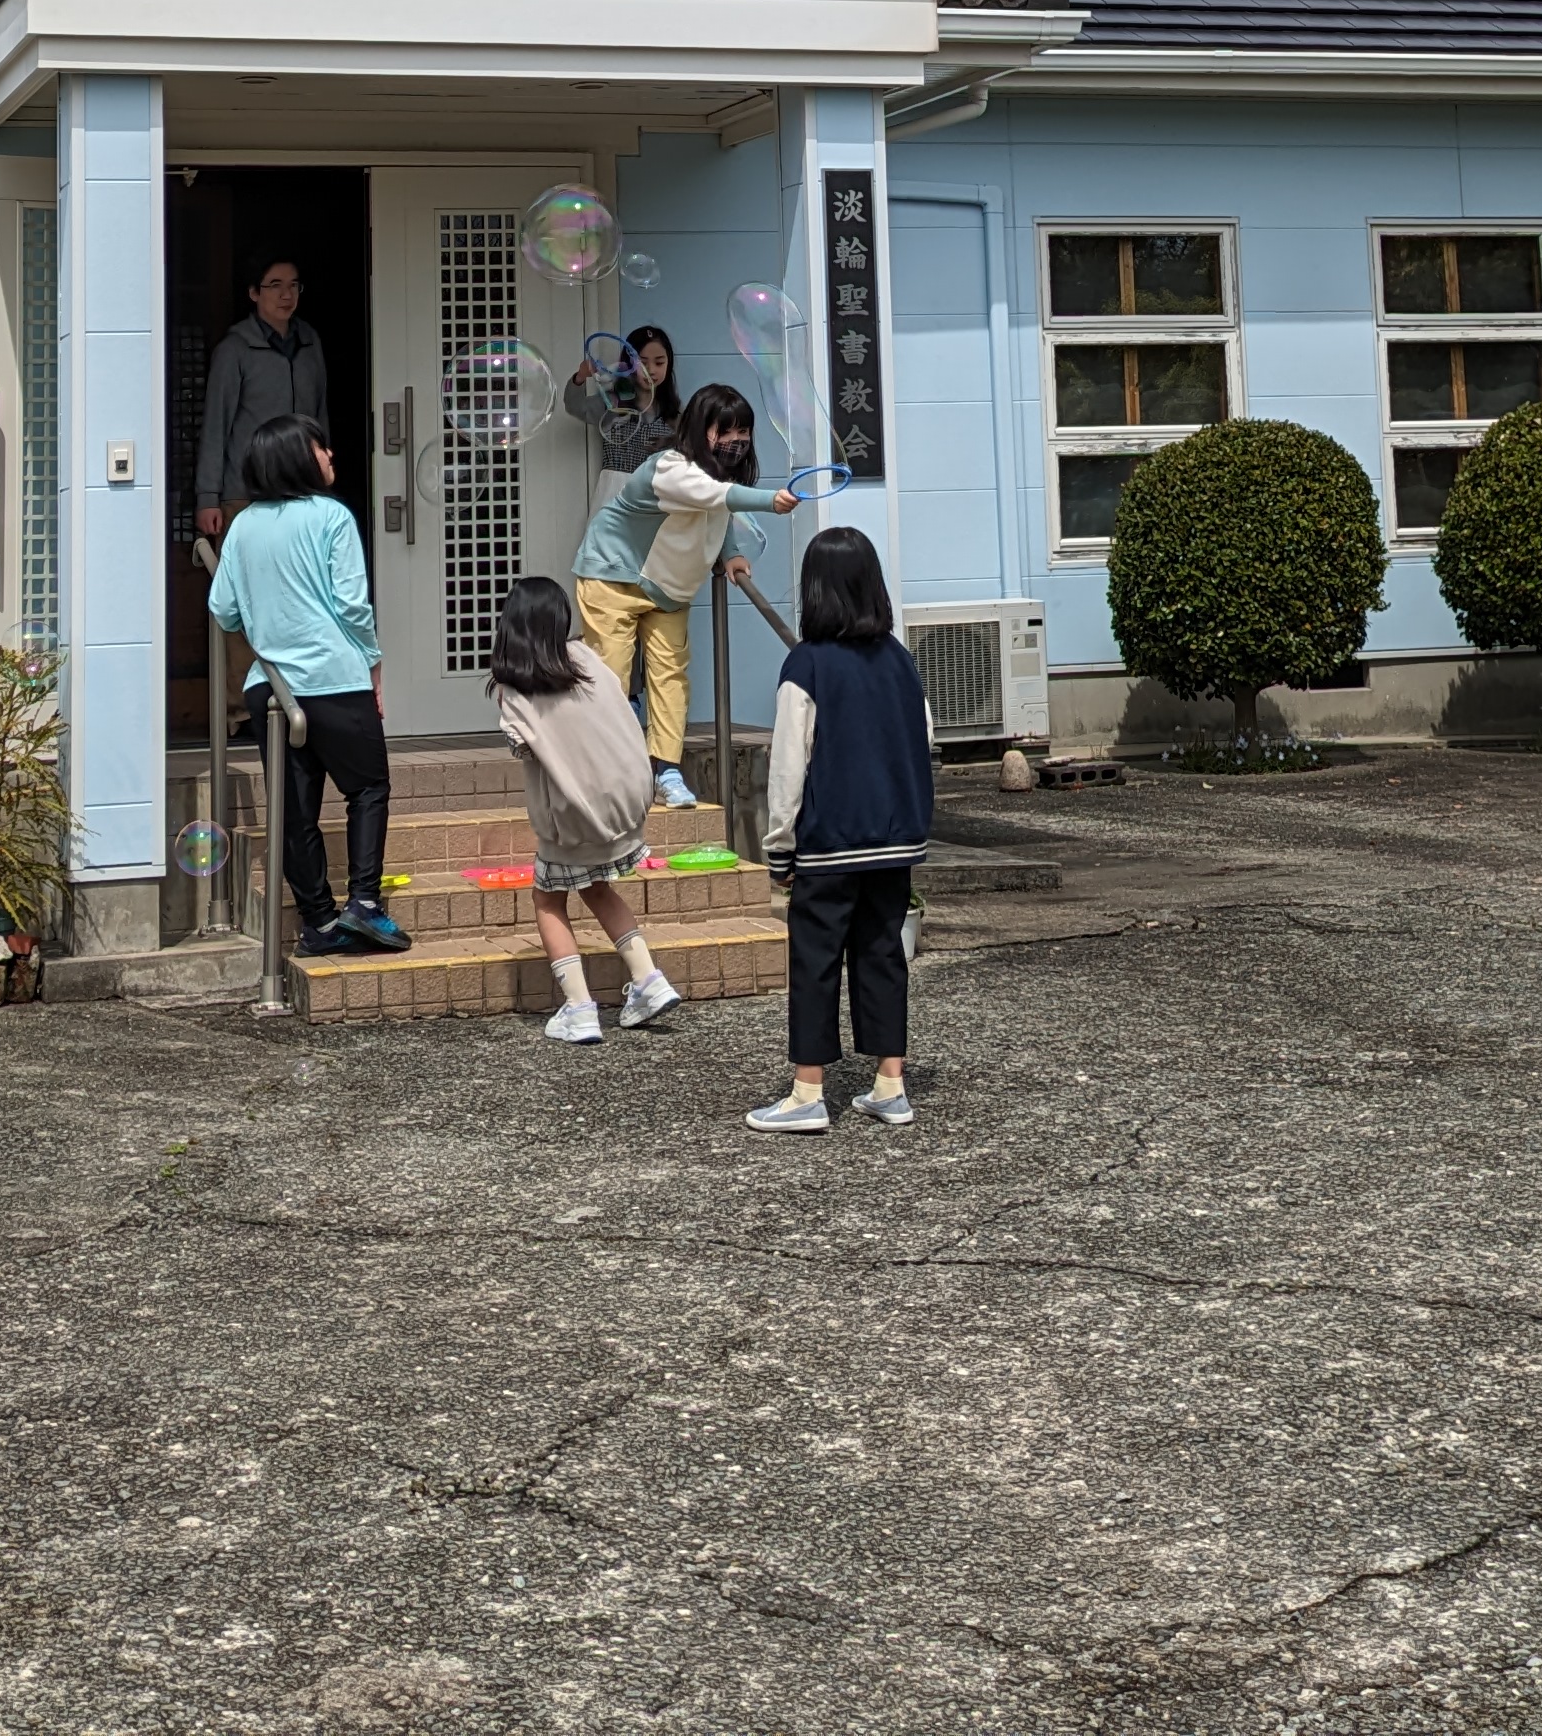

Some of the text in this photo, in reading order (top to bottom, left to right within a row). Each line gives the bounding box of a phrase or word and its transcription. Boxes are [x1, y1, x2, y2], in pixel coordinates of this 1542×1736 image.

[832, 189, 877, 459] 淡輪聖書教会
